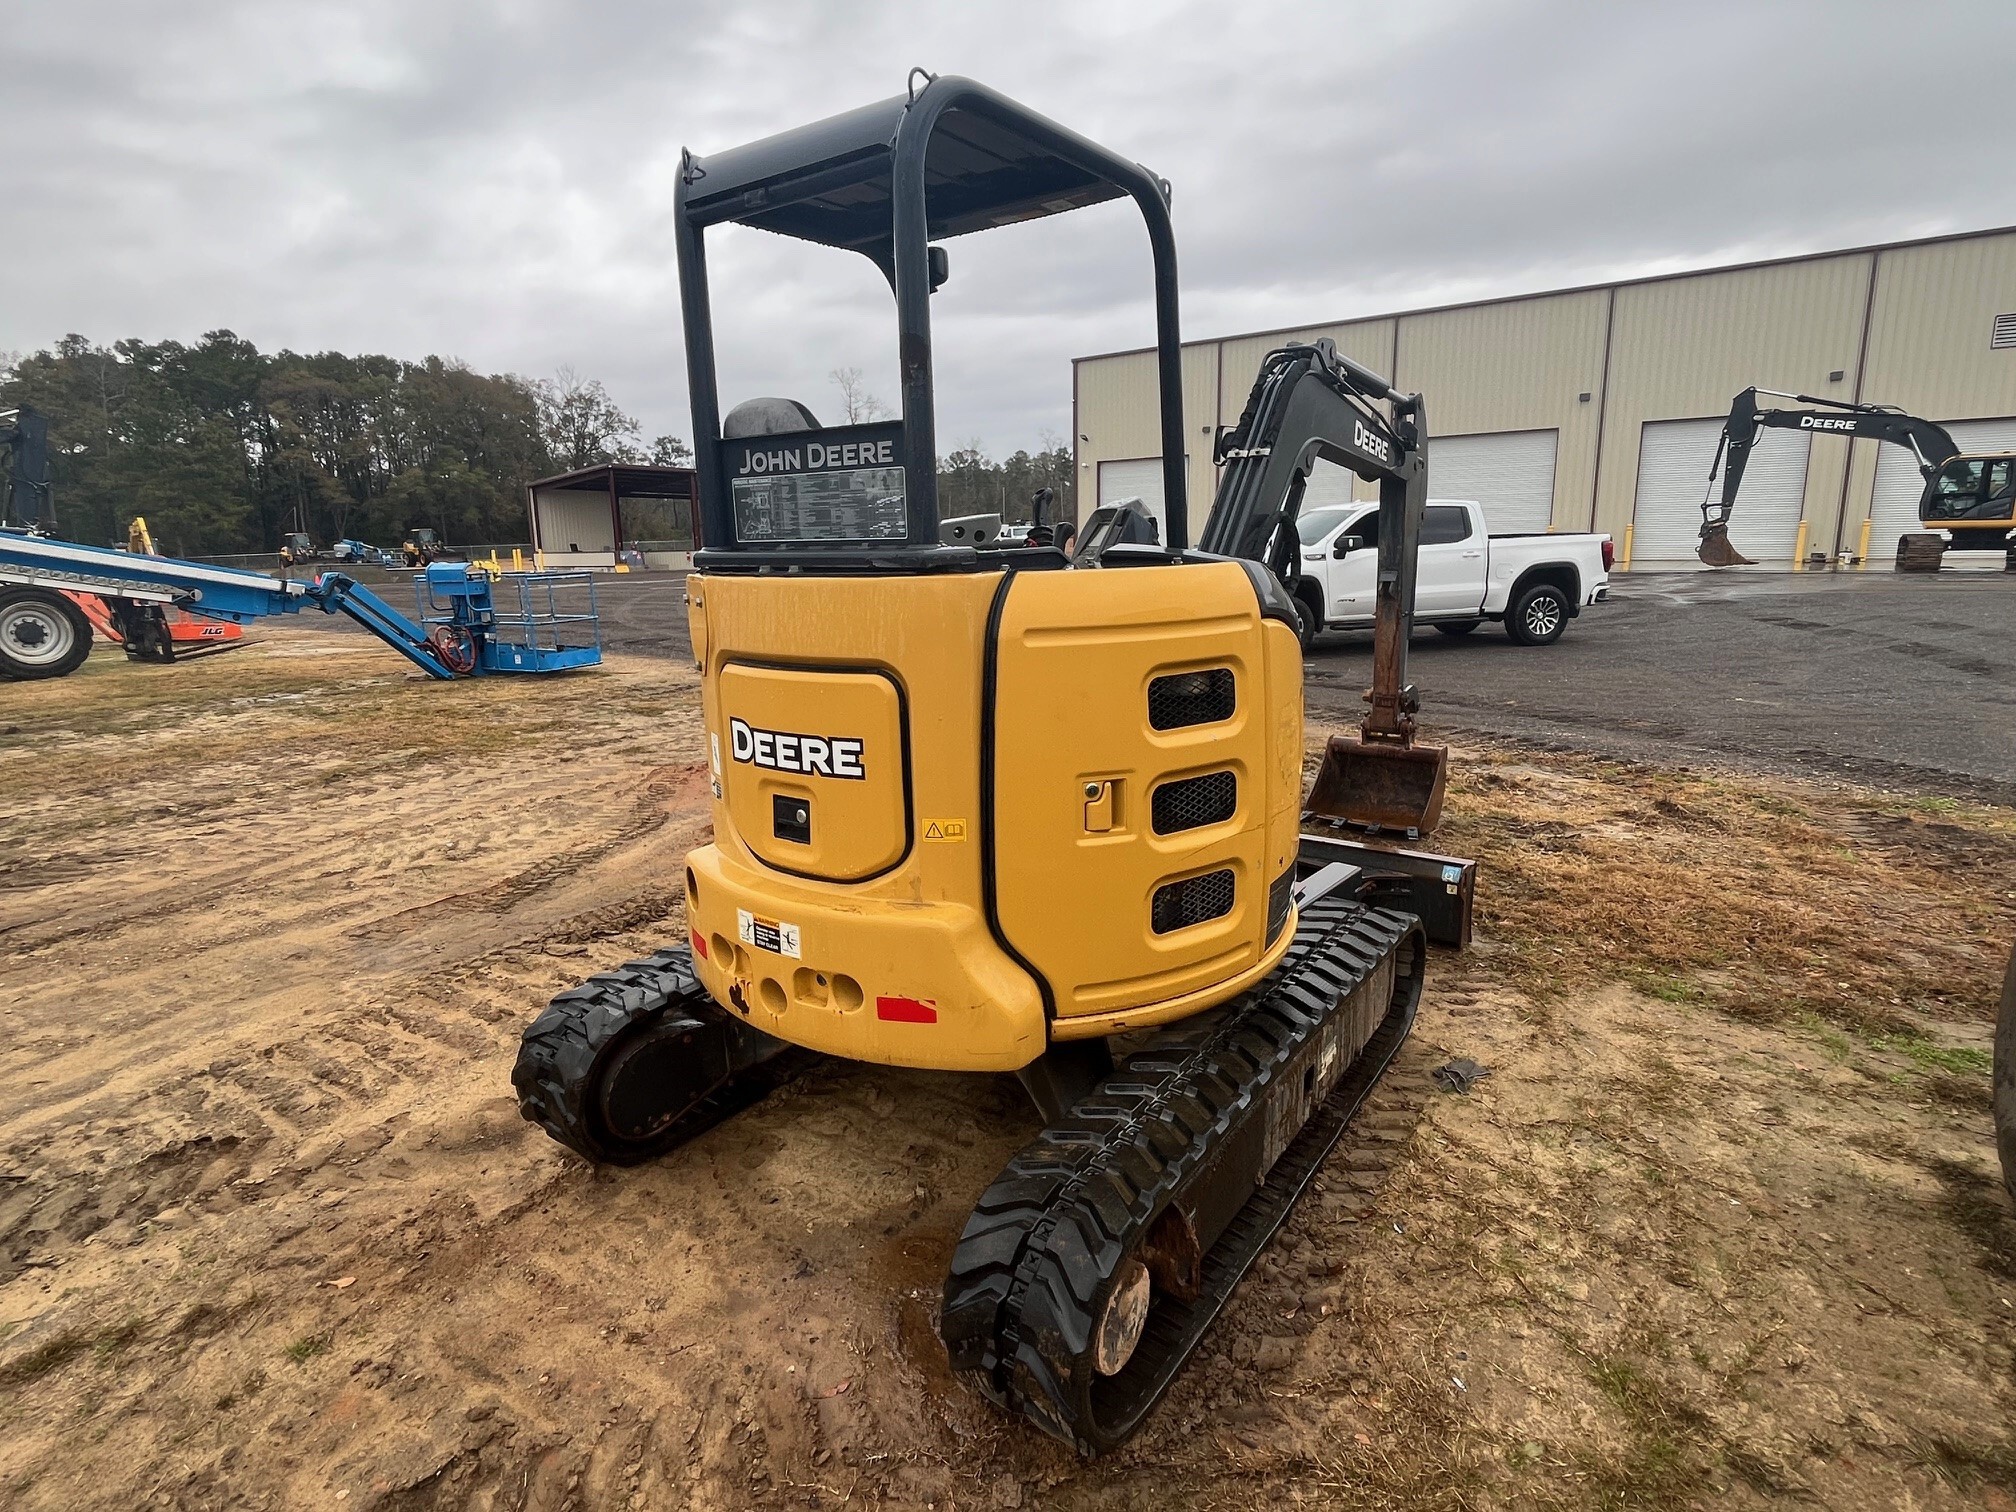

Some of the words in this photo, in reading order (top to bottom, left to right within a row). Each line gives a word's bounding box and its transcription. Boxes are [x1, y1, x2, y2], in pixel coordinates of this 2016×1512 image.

[1354, 419, 1389, 462] DEERE
[1800, 416, 1857, 430] DEERE
[739, 449, 801, 475] JOHN
[806, 440, 894, 469] DEERE
[202, 627, 224, 635] JLG
[731, 719, 864, 778] DEERE
